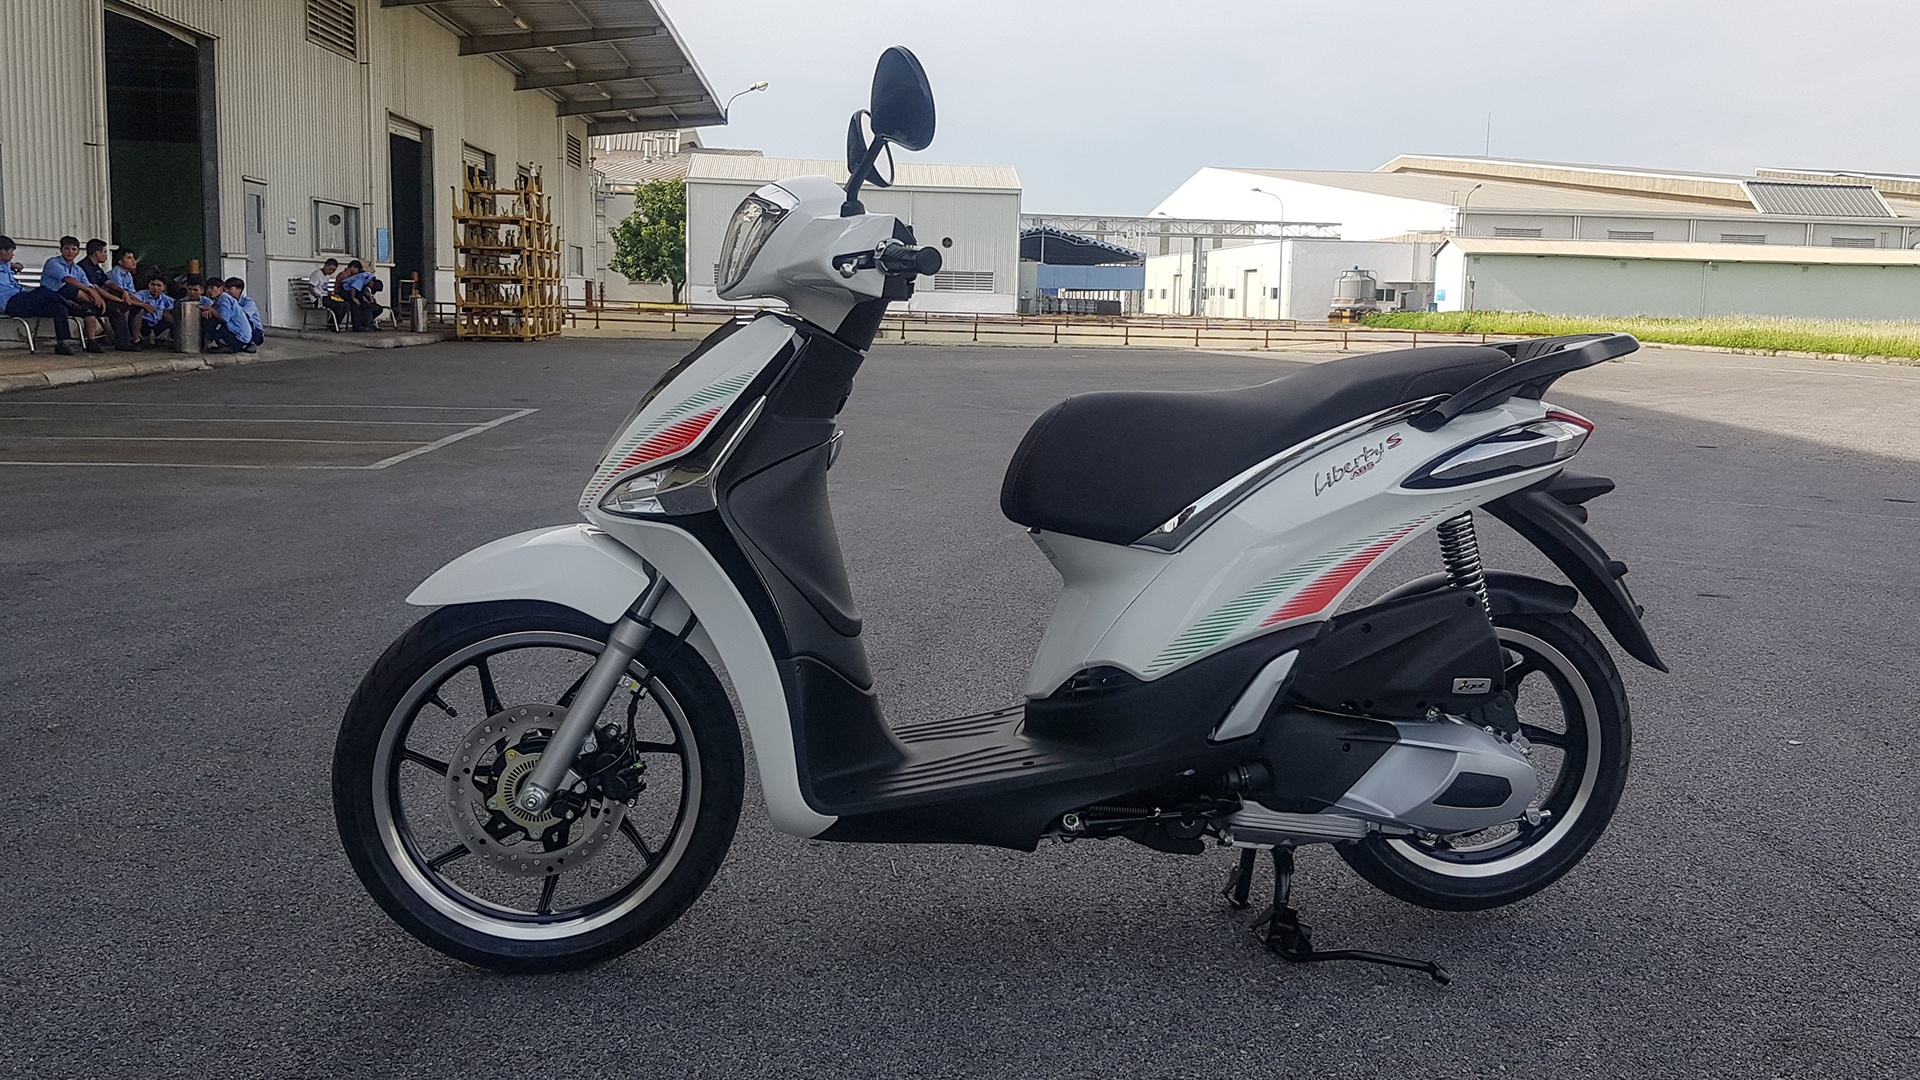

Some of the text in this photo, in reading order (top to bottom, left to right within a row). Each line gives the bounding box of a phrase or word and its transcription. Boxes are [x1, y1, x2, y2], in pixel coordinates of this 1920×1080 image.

[1314, 432, 1404, 497] Liberty S
[1350, 461, 1376, 481] ABS
